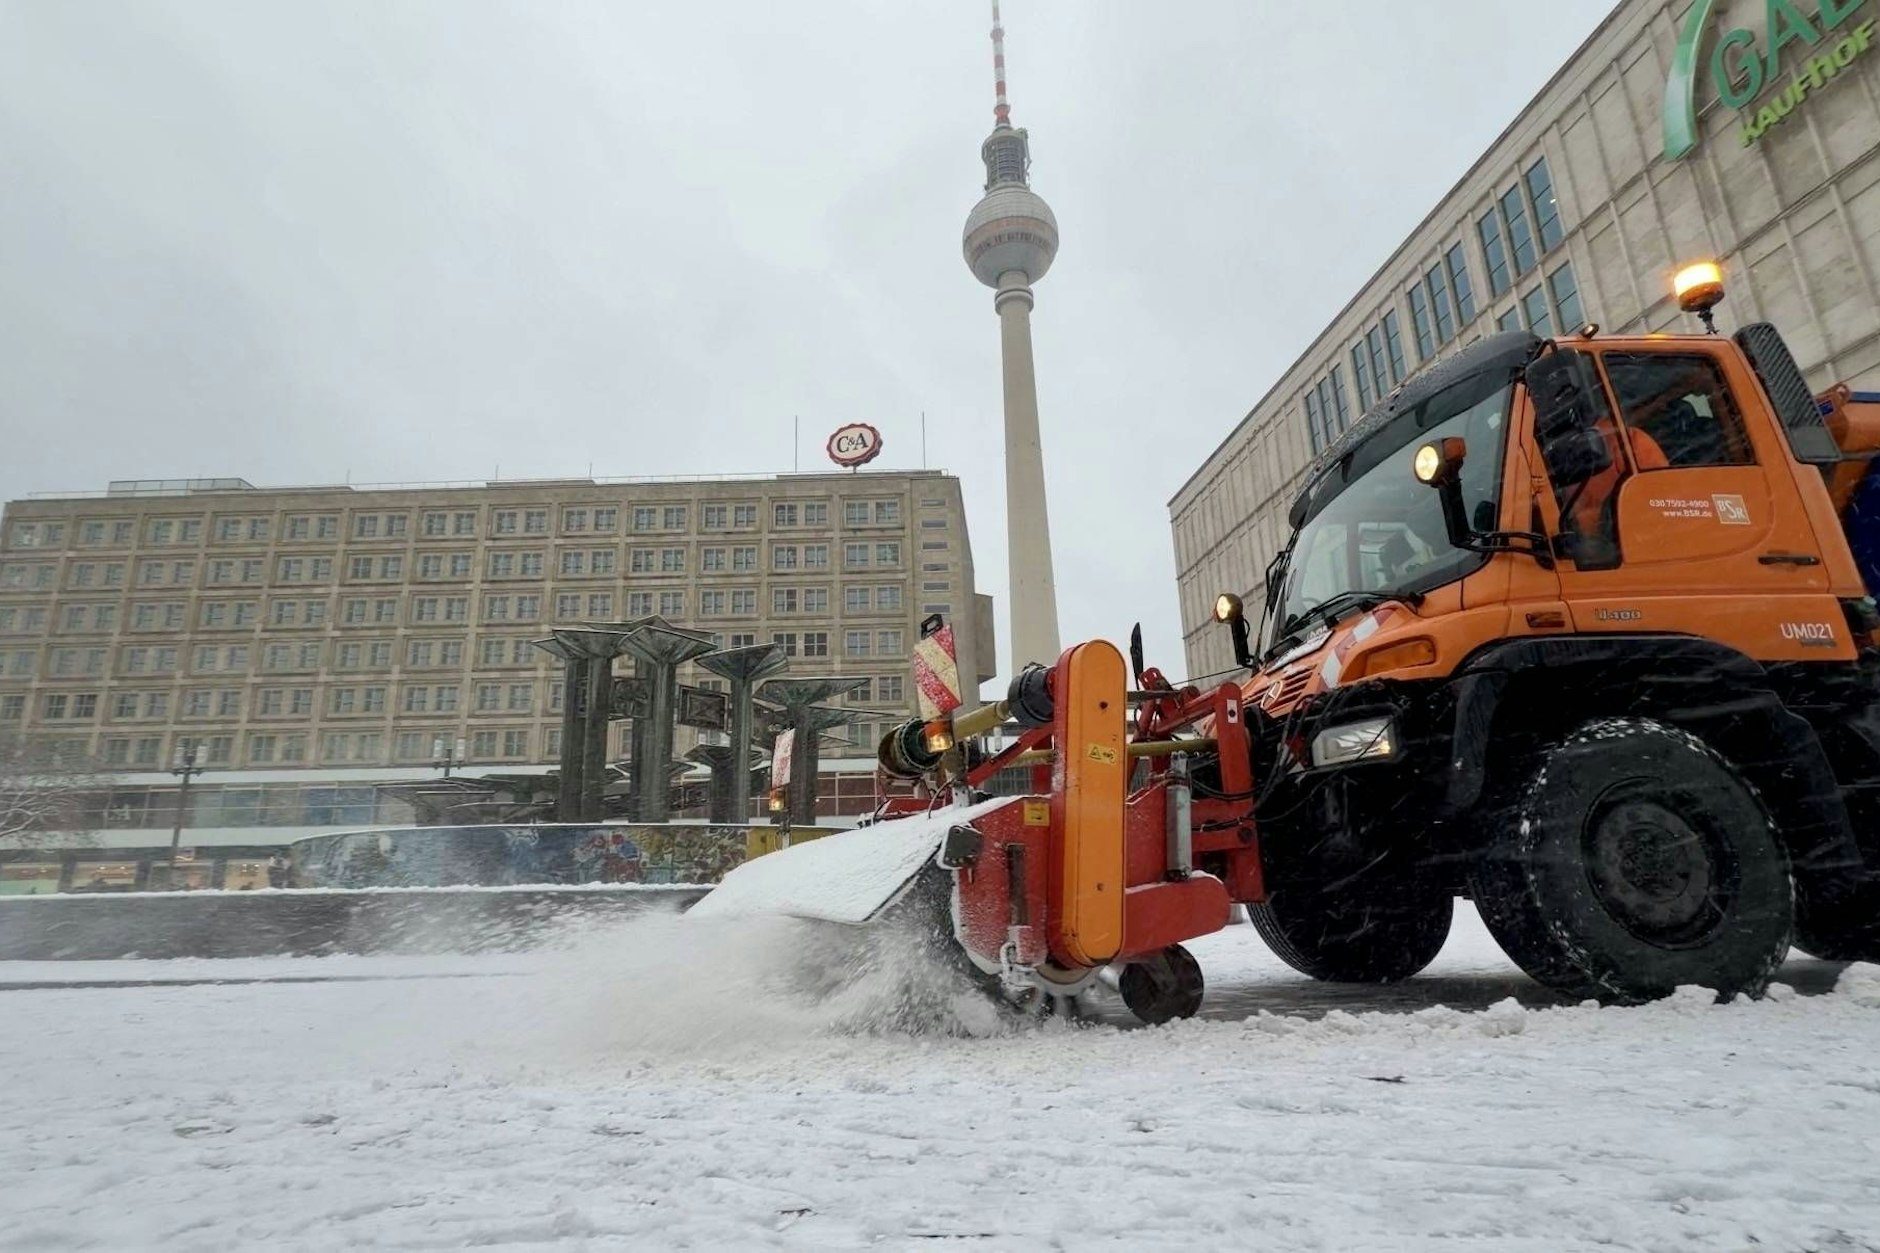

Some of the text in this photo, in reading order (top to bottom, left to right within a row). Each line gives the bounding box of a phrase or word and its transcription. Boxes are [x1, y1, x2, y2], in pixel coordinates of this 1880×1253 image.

[1740, 19, 1875, 147] KAUFHOF
[837, 433, 868, 453] C&A
[1717, 500, 1746, 519] BSR
[1780, 622, 1835, 639] UM021
